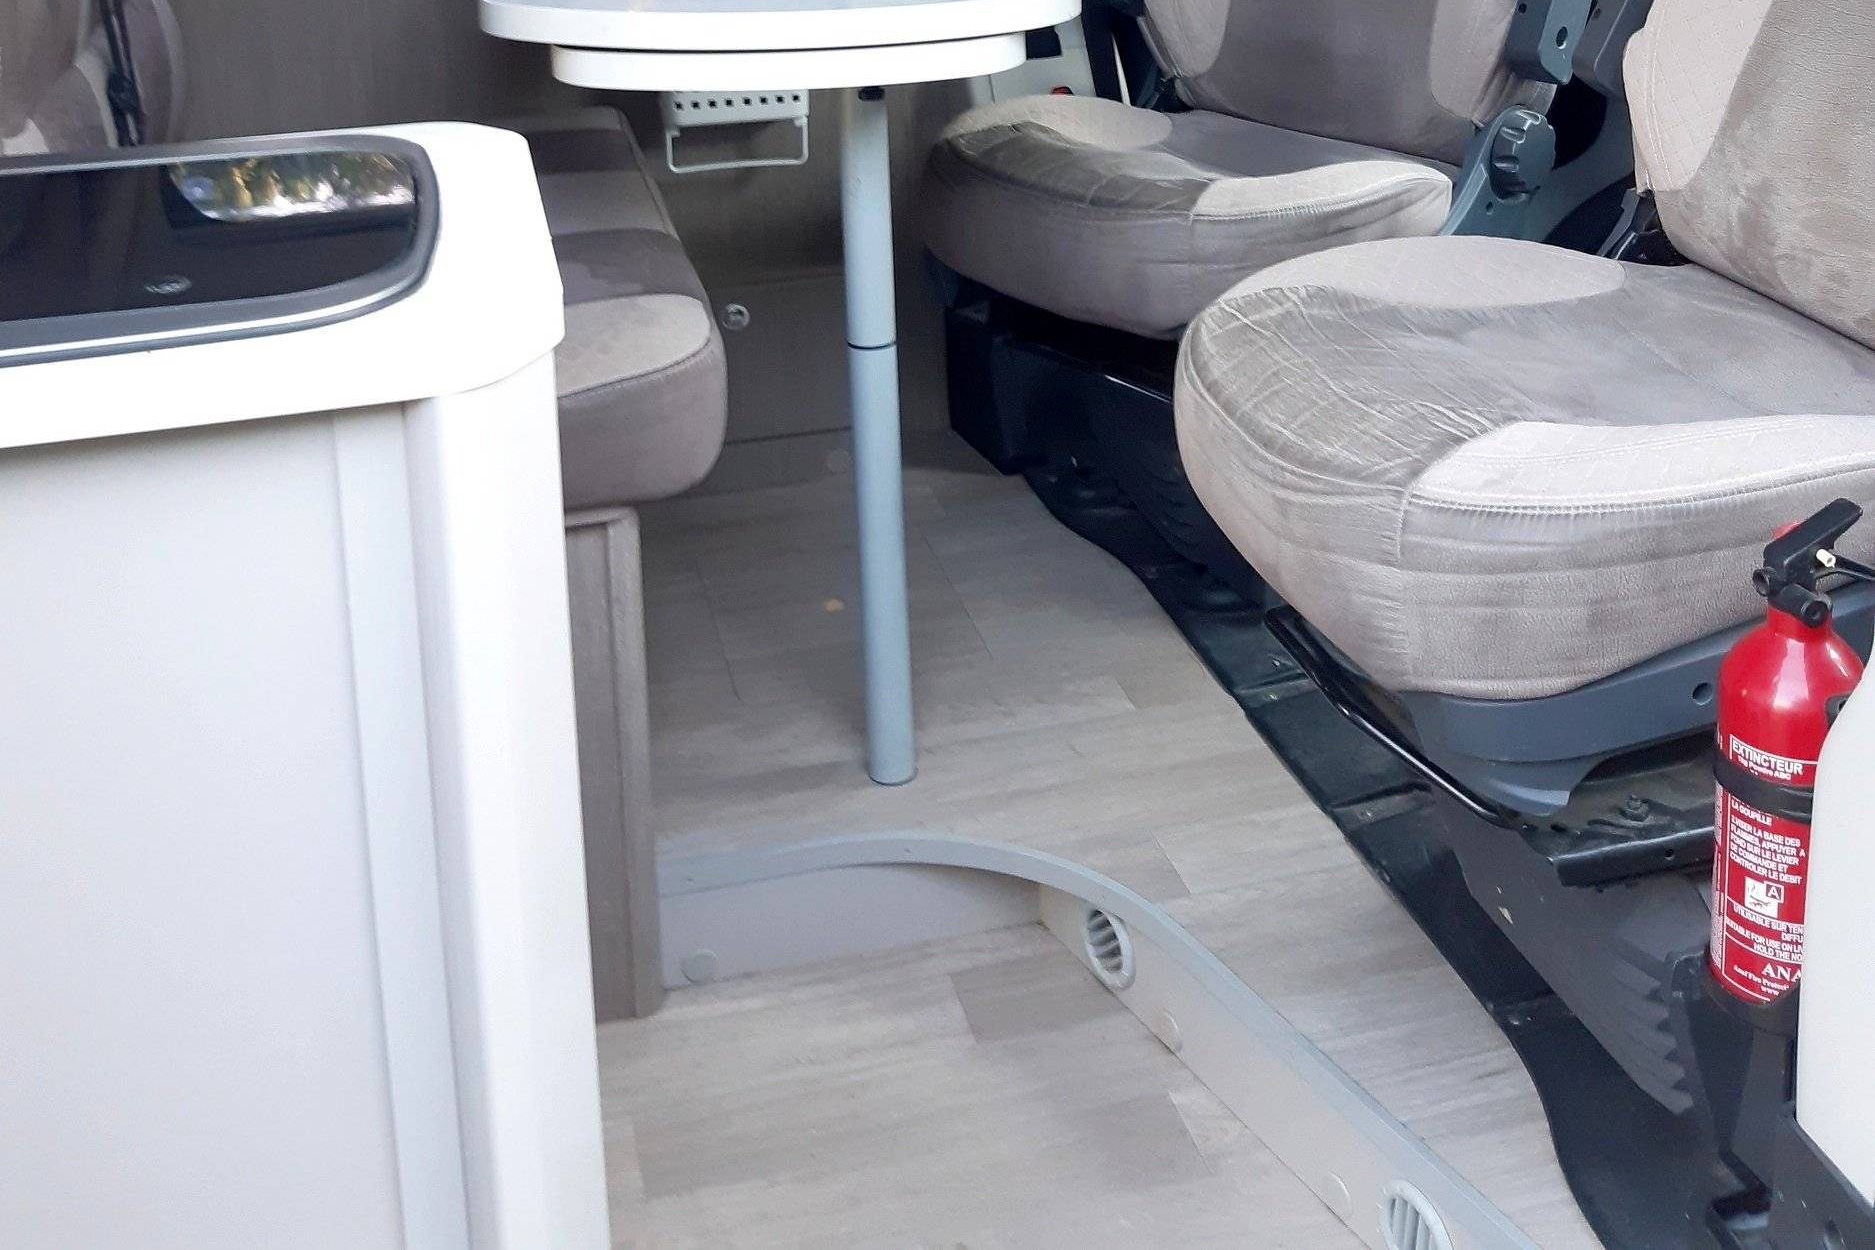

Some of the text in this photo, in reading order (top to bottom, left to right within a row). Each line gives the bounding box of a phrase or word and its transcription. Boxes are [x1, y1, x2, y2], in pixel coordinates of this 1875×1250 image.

[1732, 740, 1803, 775] EXTINCTEUR
[1763, 831, 1784, 844] BASE
[1784, 838, 1801, 847] DES
[1761, 841, 1797, 855] APPUYER
[1739, 848, 1777, 870] COMMANDE
[1777, 864, 1789, 873] ET
[1761, 849, 1772, 859] LE
[1772, 853, 1800, 865] LEVIER
[1730, 851, 1768, 876] CONTROLER
[1768, 871, 1779, 880] LE
[1771, 922, 1788, 931] SUR
[1751, 932, 1766, 945] FOR
[1766, 938, 1781, 949] USE
[1781, 942, 1793, 951] ON
[1753, 943, 1775, 956] HOLD
[1775, 949, 1791, 959] THE
